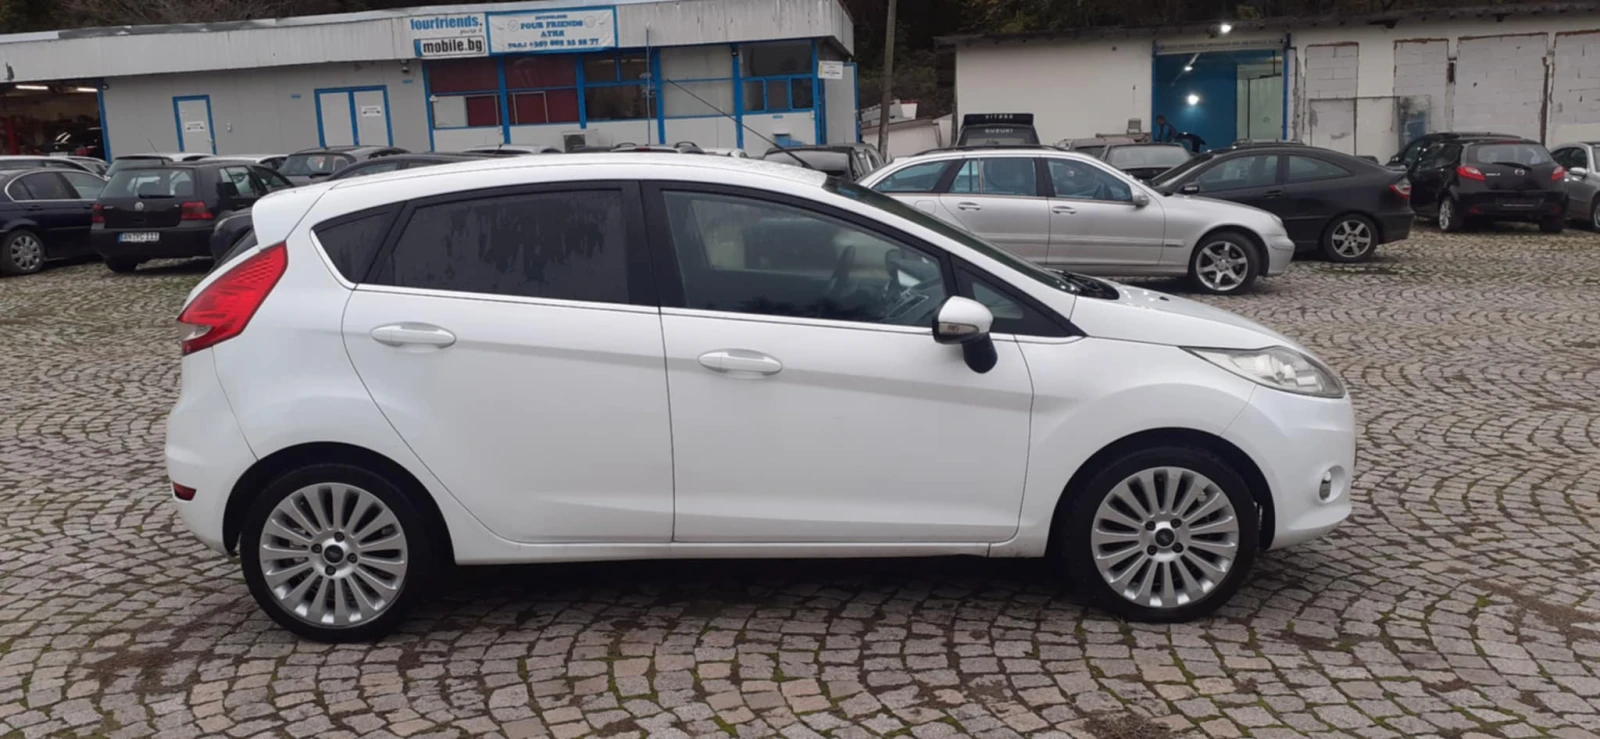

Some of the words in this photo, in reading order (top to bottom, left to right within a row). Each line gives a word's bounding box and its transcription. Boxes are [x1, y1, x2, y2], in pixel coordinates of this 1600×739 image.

[410, 15, 482, 30] fourfriends.
[520, 21, 544, 30] FOUR
[546, 20, 583, 29] FRIENDS
[423, 38, 483, 53] mobile.bg
